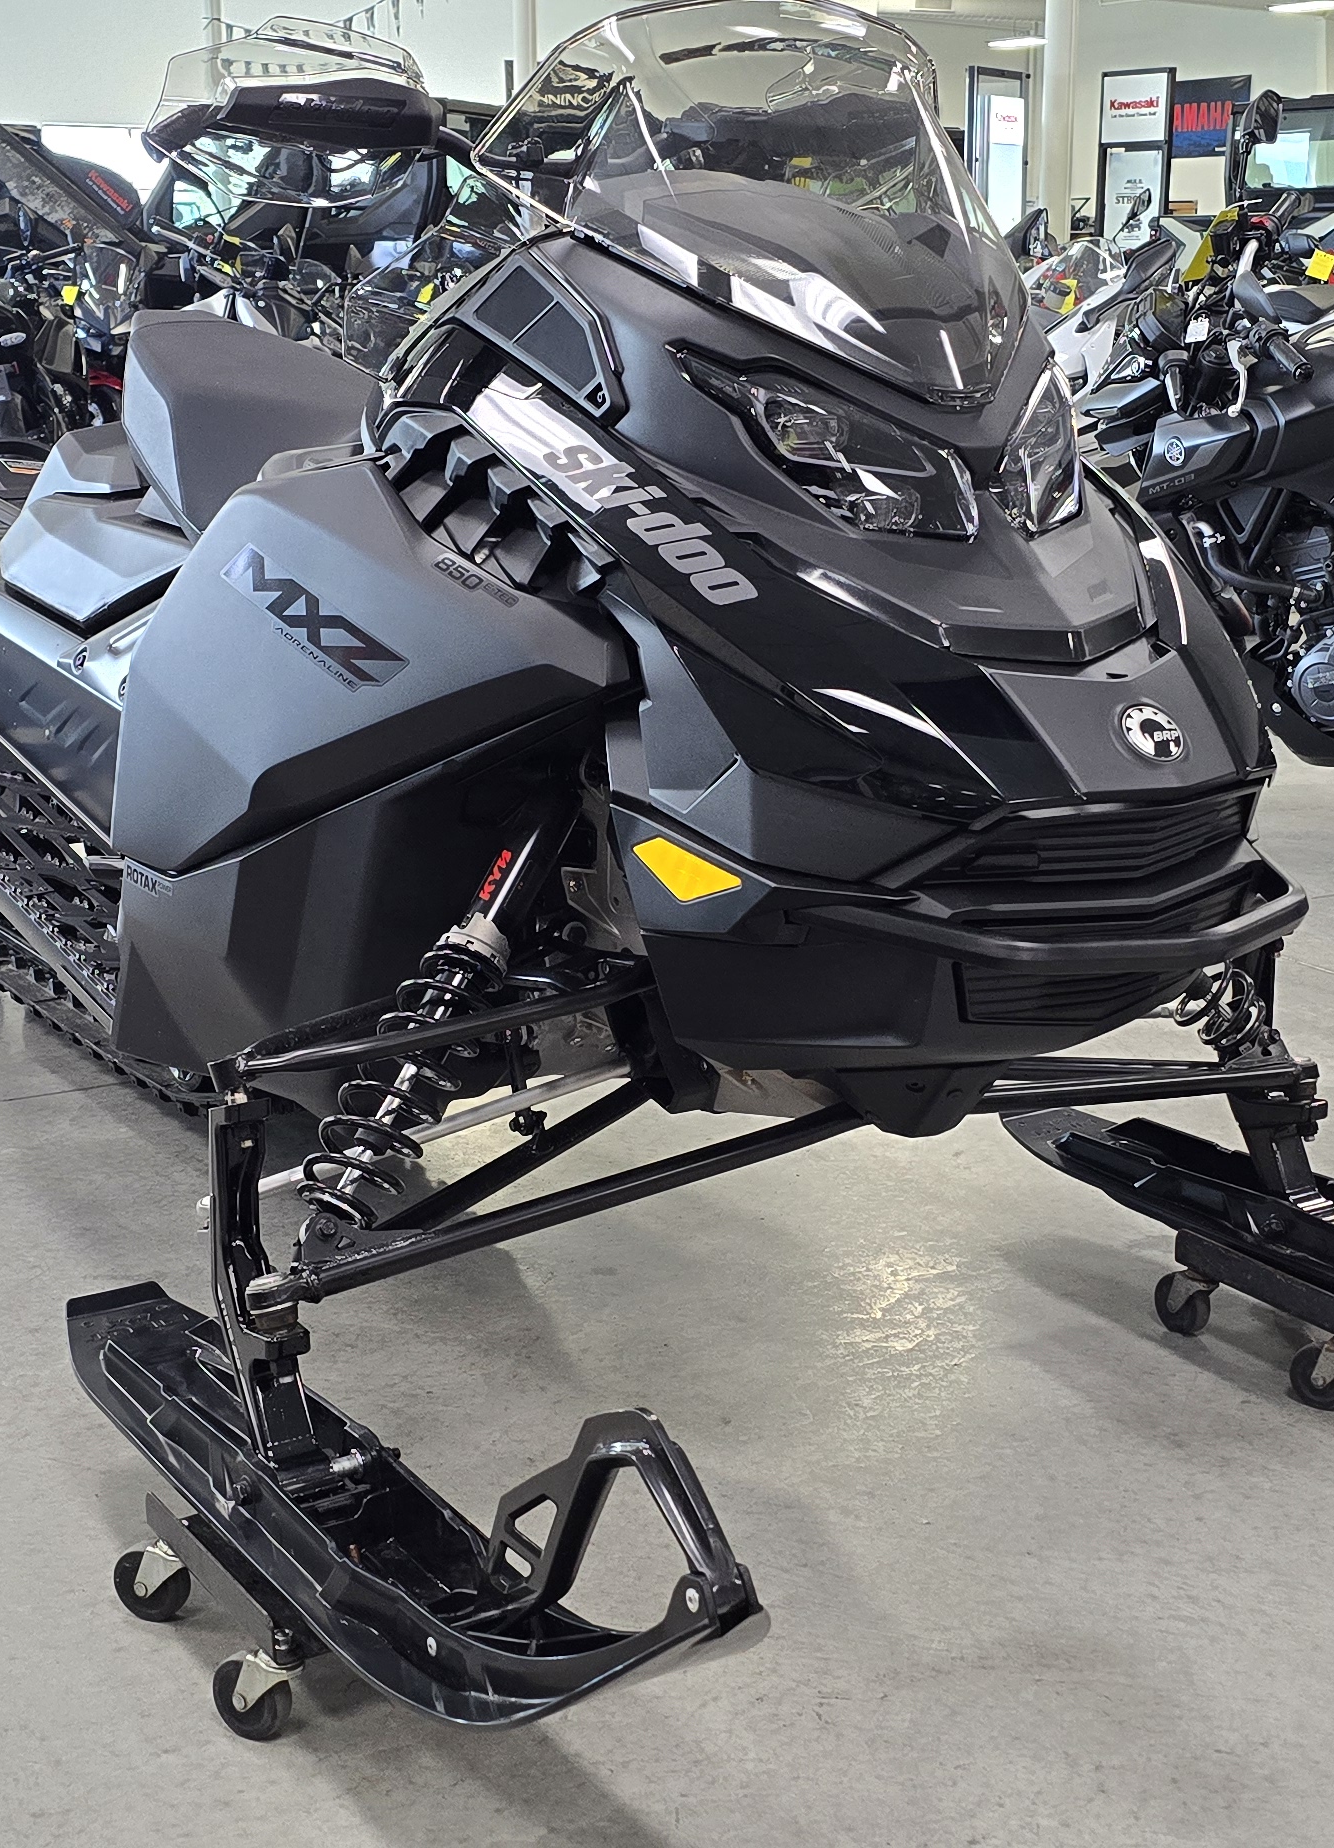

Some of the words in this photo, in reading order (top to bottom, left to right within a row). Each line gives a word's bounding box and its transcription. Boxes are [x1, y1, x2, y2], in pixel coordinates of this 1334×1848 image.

[1109, 95, 1160, 111] Kawasaki
[1173, 101, 1233, 132] AMAHA
[88, 169, 134, 212] Kawasaki
[1148, 473, 1195, 495] MT-03
[433, 556, 485, 590] 850
[483, 582, 517, 606] E-TEC
[222, 547, 406, 684] MXZ
[274, 626, 359, 690] ADRENALINE
[1153, 730, 1179, 742] BRP
[126, 864, 158, 896] ROTAX
